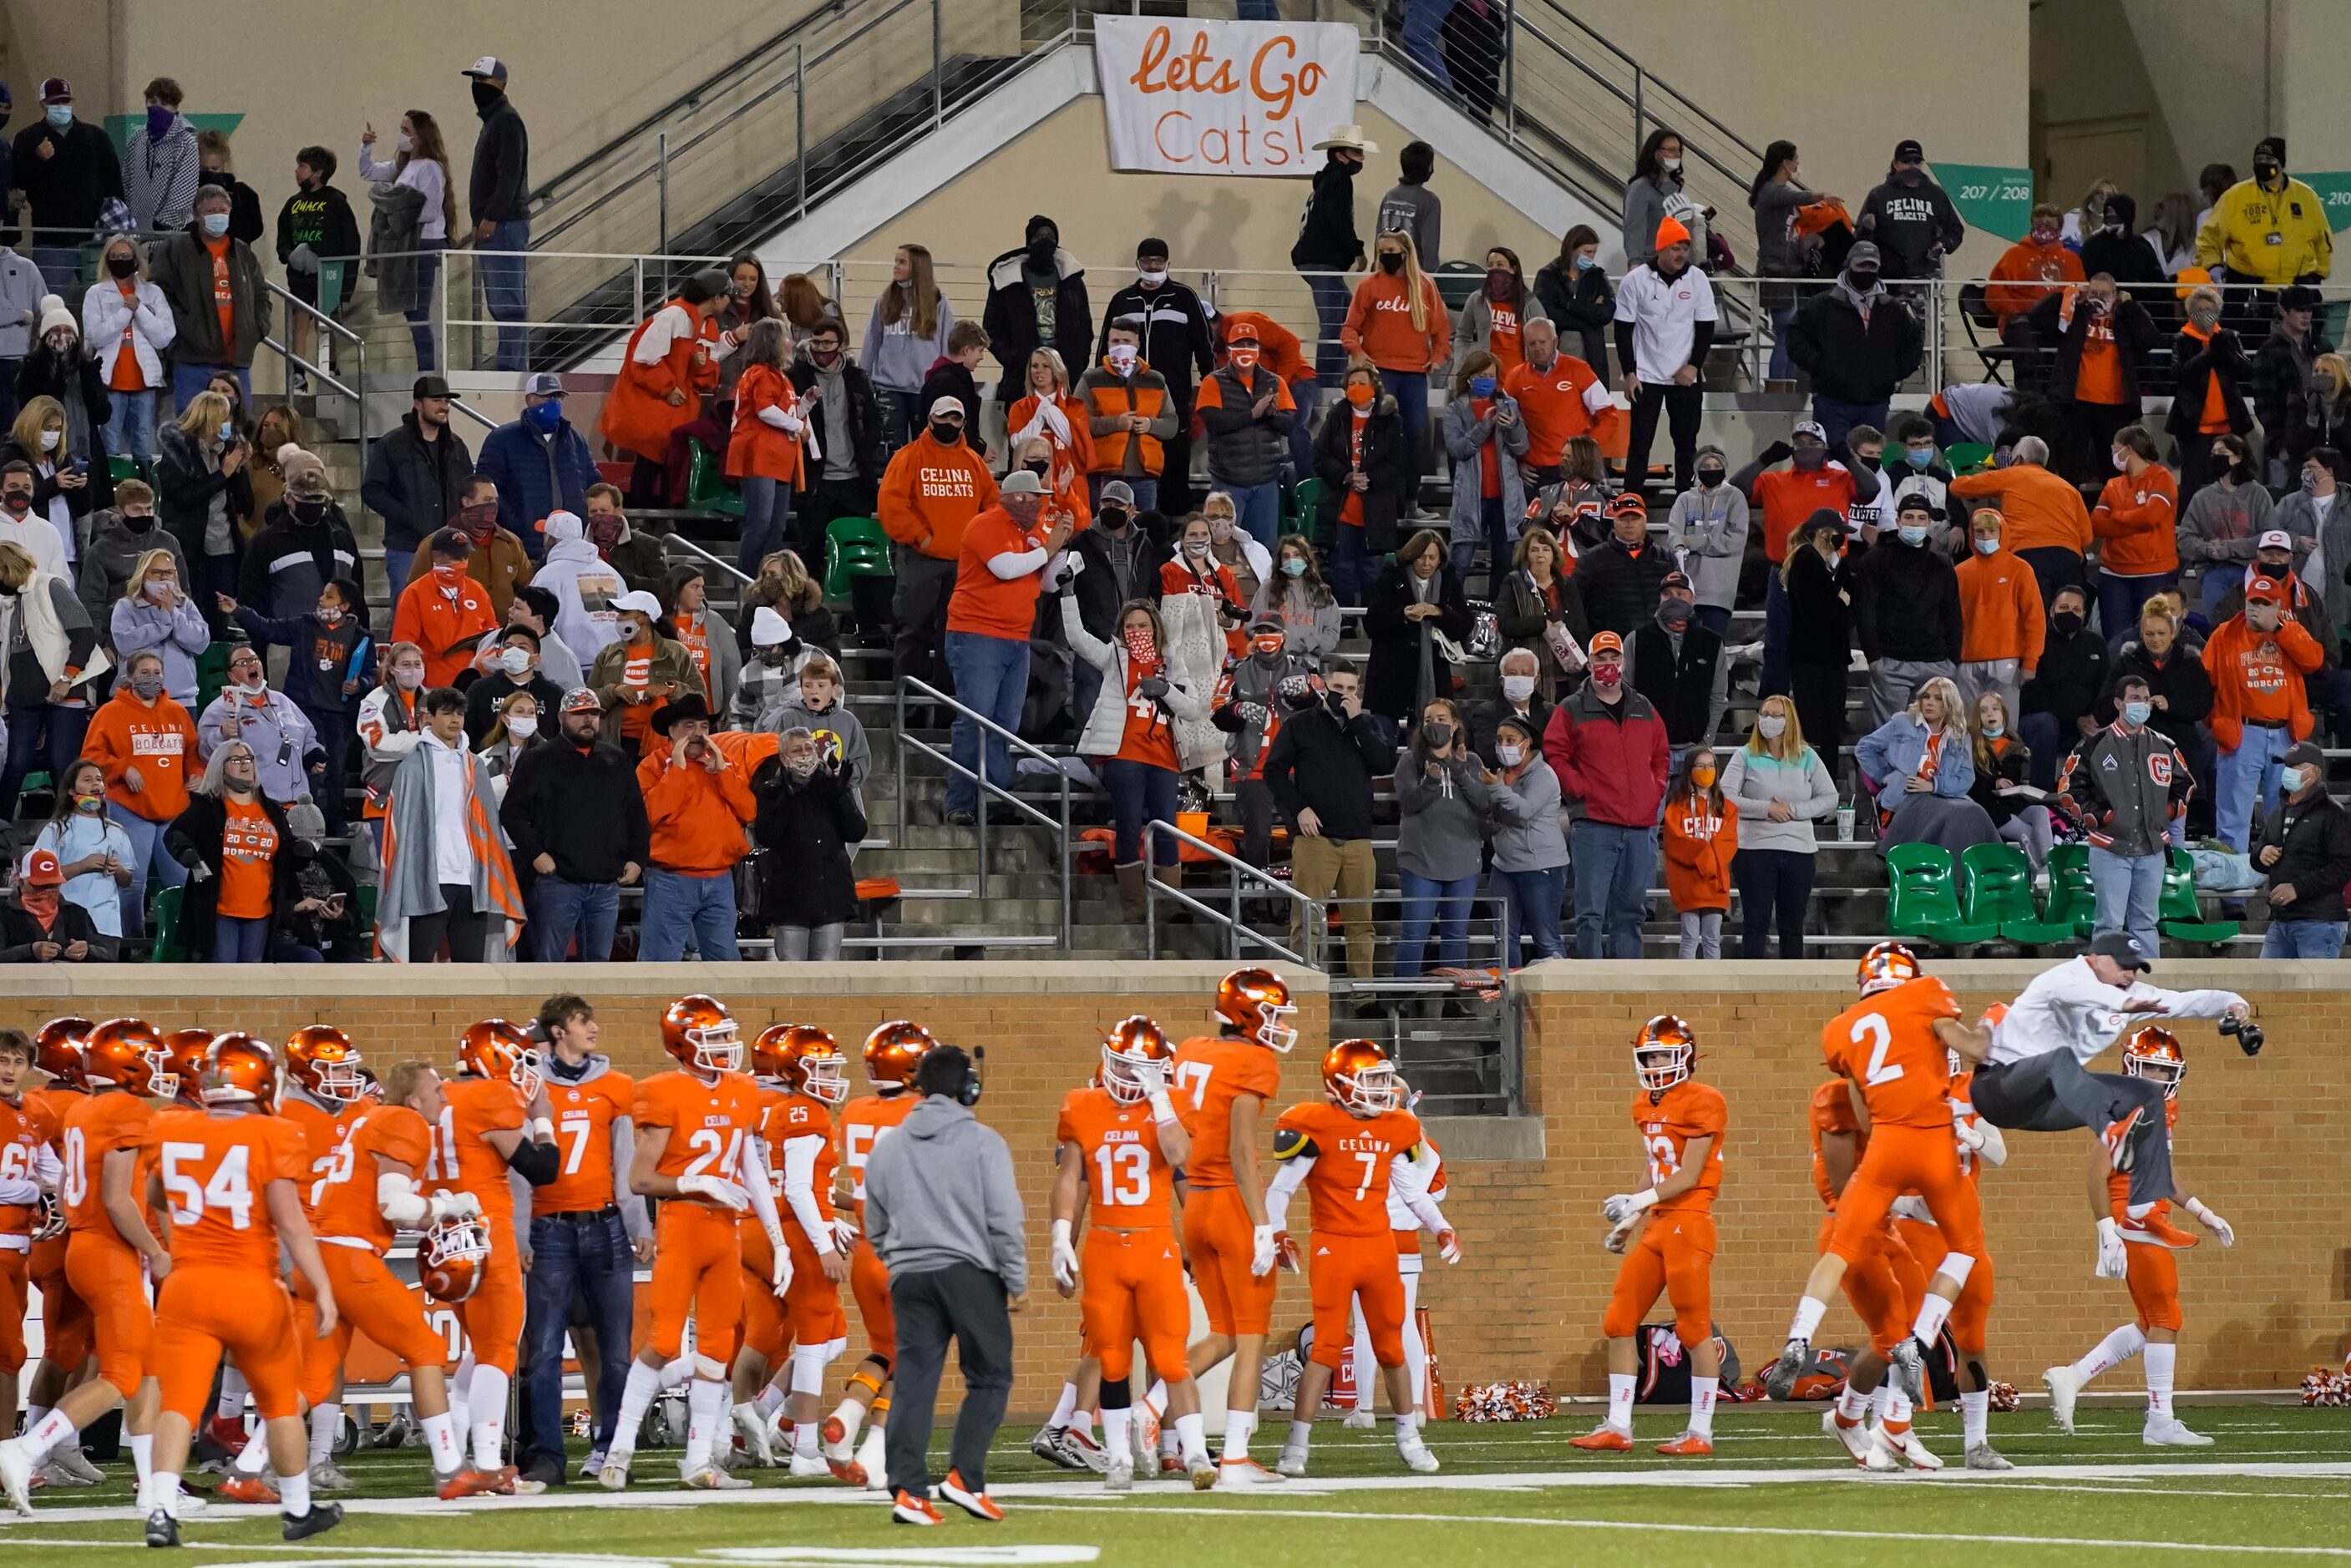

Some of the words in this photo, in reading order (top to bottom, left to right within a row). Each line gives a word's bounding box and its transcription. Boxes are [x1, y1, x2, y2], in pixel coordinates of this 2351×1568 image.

[1130, 25, 1240, 94] lets
[1250, 36, 1328, 121] Go
[1154, 110, 1306, 165] Cats!
[1960, 185, 1988, 199] 207
[1989, 185, 1999, 201] /
[2001, 185, 2030, 200] 208
[2328, 191, 2351, 206] 210
[291, 201, 327, 215] QUACK
[1886, 199, 1935, 216] CELINA
[921, 468, 973, 483] CELINA
[923, 483, 974, 497] BOBCATS
[2148, 753, 2172, 787] C
[227, 833, 240, 843] 20
[260, 837, 274, 847] 20
[223, 847, 271, 860] BOBCATS
[1850, 1012, 1905, 1086] 2
[790, 1105, 811, 1124] 25
[560, 1120, 591, 1175] 7
[1103, 1130, 1140, 1142] CELINA
[1339, 1137, 1391, 1152] CELINA
[65, 1127, 90, 1207] 0
[685, 1128, 743, 1182] 24
[846, 1124, 887, 1201] 5
[162, 1141, 254, 1231] 54
[1094, 1144, 1151, 1206] 13
[1355, 1153, 1377, 1201] 7
